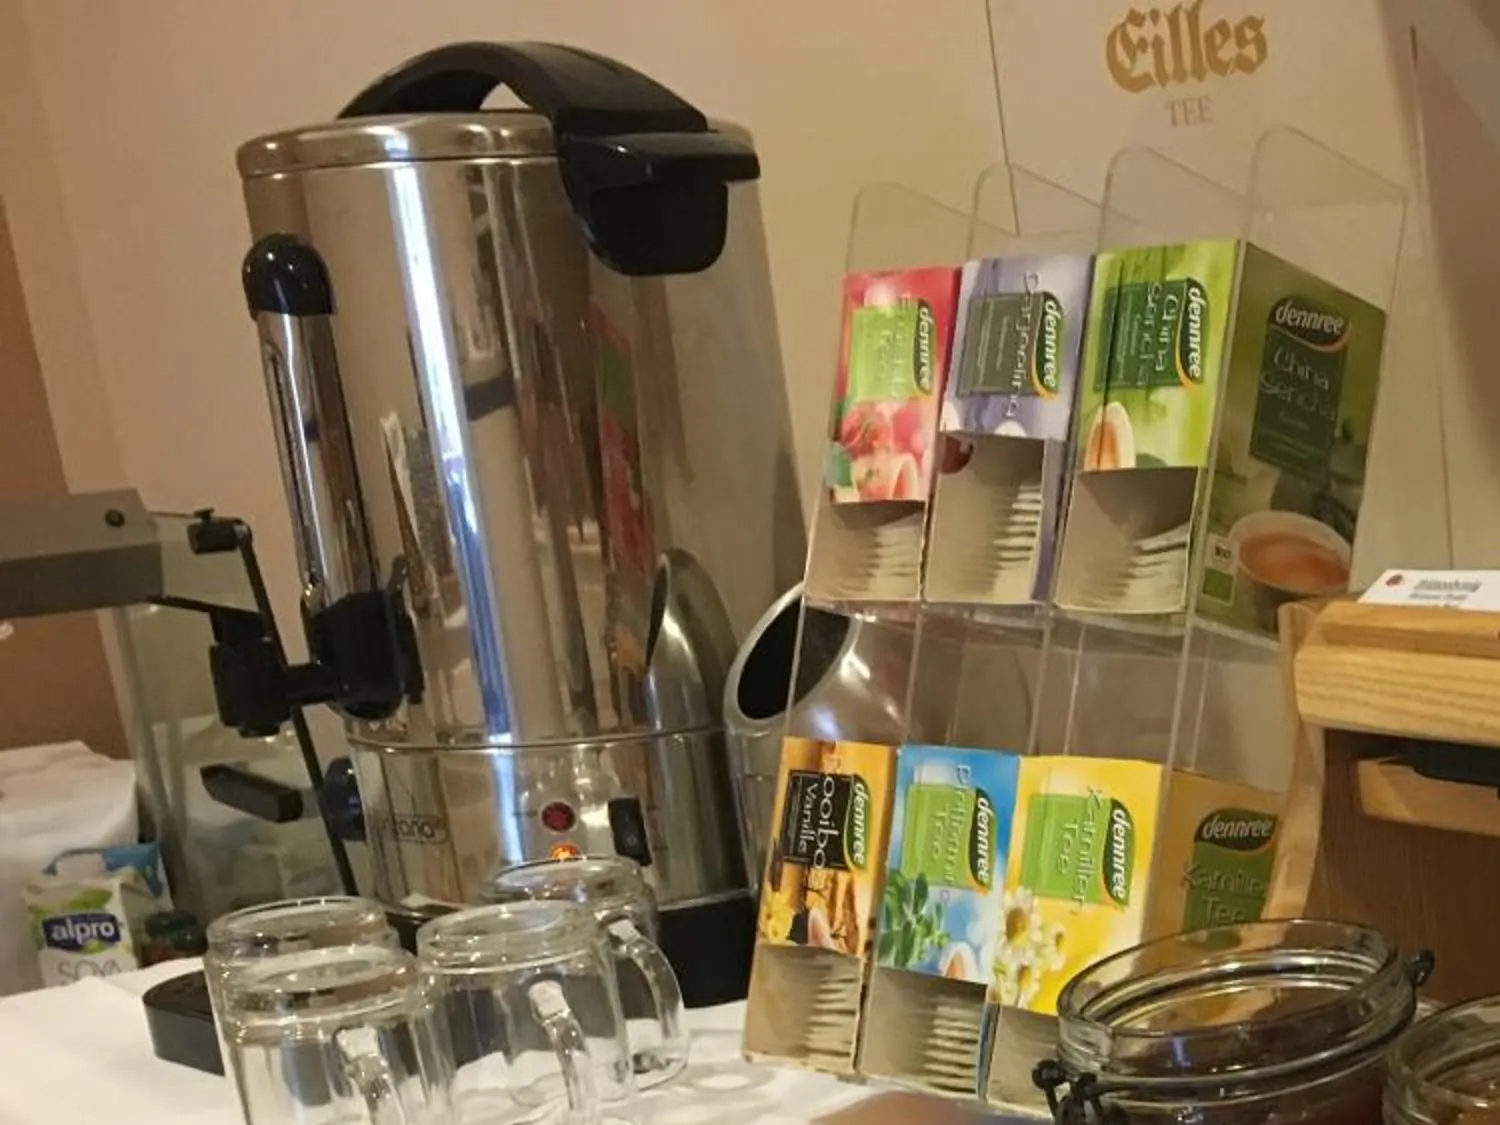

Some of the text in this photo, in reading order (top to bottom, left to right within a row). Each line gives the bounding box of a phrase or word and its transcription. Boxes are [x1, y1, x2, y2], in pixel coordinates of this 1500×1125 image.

[1106, 0, 1268, 94] Eilles
[1164, 95, 1214, 128] TEE
[918, 306, 934, 390] dennree
[1043, 299, 1062, 388] dennree
[1156, 294, 1178, 372] China
[1187, 286, 1207, 379] dennree
[1274, 299, 1345, 336] dennree
[1273, 349, 1330, 390] China
[799, 782, 820, 854] Vanille
[852, 781, 869, 865] dennree
[976, 796, 994, 883] dennree
[1056, 818, 1079, 876] Tee
[1110, 808, 1132, 899] dennree
[1202, 815, 1274, 839] dennree
[52, 916, 115, 945] alpro
[1202, 896, 1247, 924] Tee
